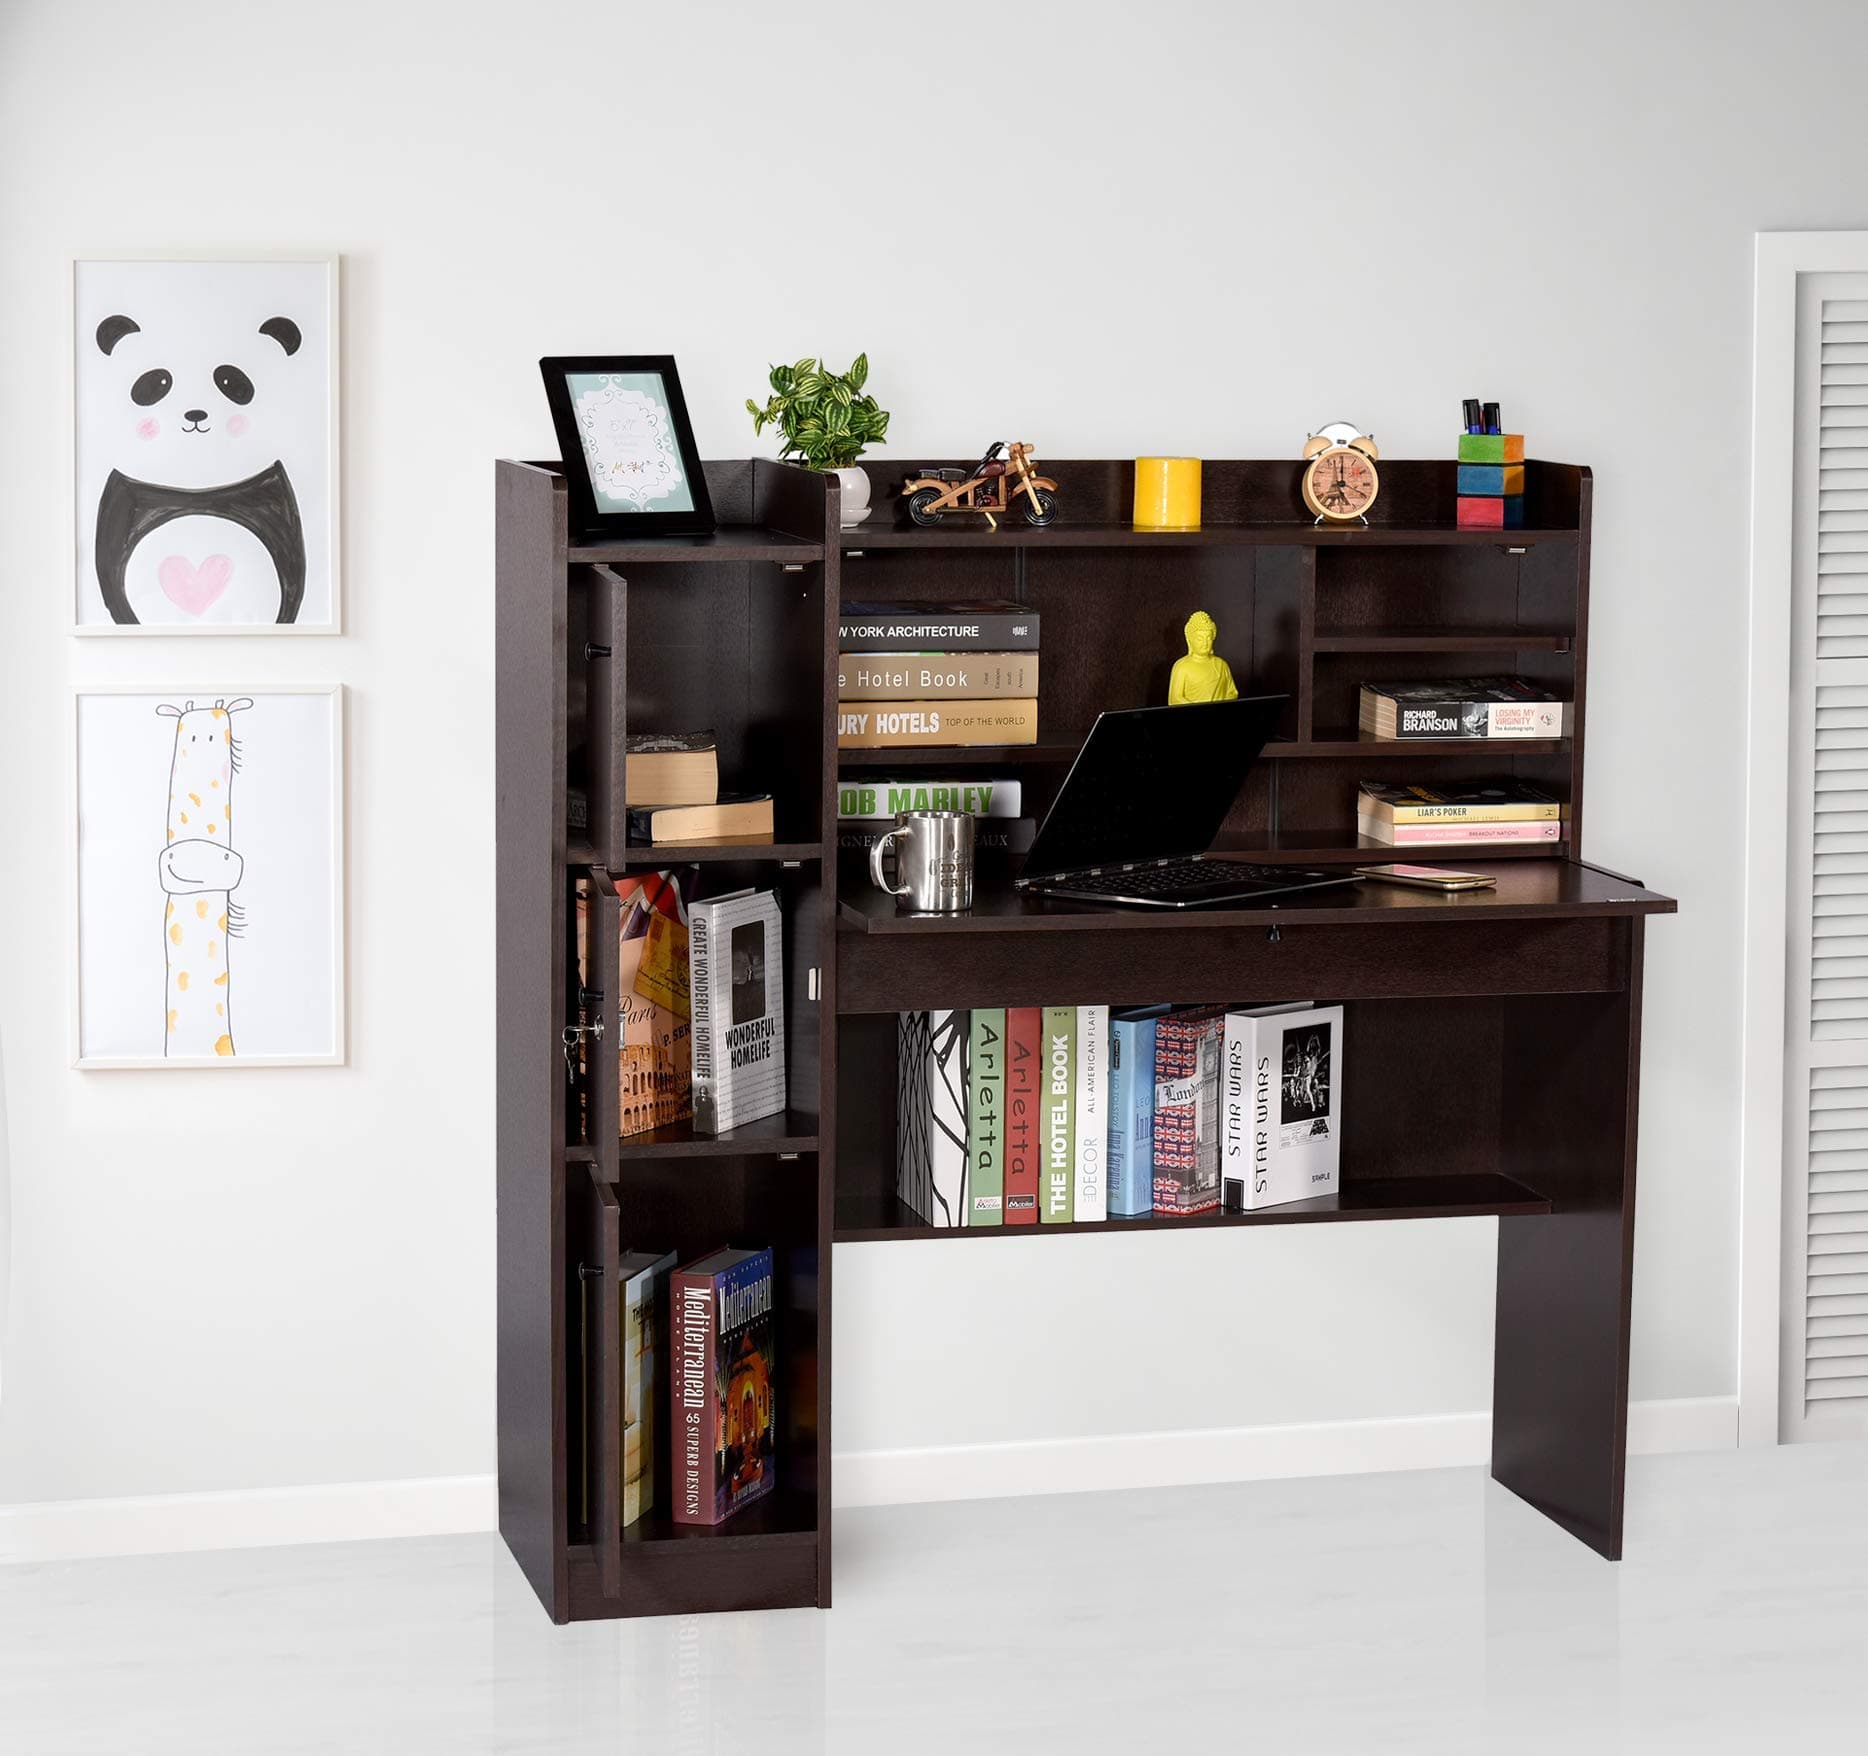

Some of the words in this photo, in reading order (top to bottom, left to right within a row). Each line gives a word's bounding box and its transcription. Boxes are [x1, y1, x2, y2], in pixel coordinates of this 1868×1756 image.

[850, 626, 885, 638] YORK
[887, 625, 980, 638] ARCHITECTURE
[857, 670, 909, 688] Hotel
[920, 670, 968, 688] Book
[876, 712, 940, 734] HOTELS
[964, 718, 974, 726] OF
[977, 718, 993, 726] THE
[995, 717, 1026, 726] WORLD
[1403, 711, 1437, 719] RICHARD
[1403, 719, 1458, 731] BRANSON
[1495, 709, 1520, 717] LOSING
[1495, 717, 1530, 725] VIRGINITY
[1417, 808, 1442, 817] LIAR'S
[1443, 807, 1467, 816] POKER
[692, 916, 707, 956] CREATE
[693, 957, 709, 1024] WONDERFUL
[725, 1018, 775, 1050] WONDERFUL
[1088, 1009, 1097, 1035] FLAIR
[696, 1026, 711, 1079] HOMELIFE
[730, 1042, 771, 1070] HOMELIFE
[1051, 1034, 1069, 1095] BOOK
[1229, 1039, 1242, 1097] WARS
[978, 1023, 999, 1170] Arletta
[1087, 1037, 1096, 1113] ALL-AMERICAN
[1256, 1055, 1270, 1123] WARS
[1011, 1040, 1032, 1175] Arletta
[1051, 1099, 1069, 1169] HOTEL
[1228, 1103, 1242, 1158] STAR
[1081, 1137, 1098, 1202] DECOR
[1255, 1129, 1268, 1194] STAR
[1051, 1173, 1068, 1216] THE
[719, 1275, 773, 1336] Mediterranean
[683, 1286, 712, 1408] Mediterranean
[685, 1412, 701, 1424] 65
[685, 1425, 700, 1467] SUPERB
[685, 1469, 700, 1516] DESIGNS
